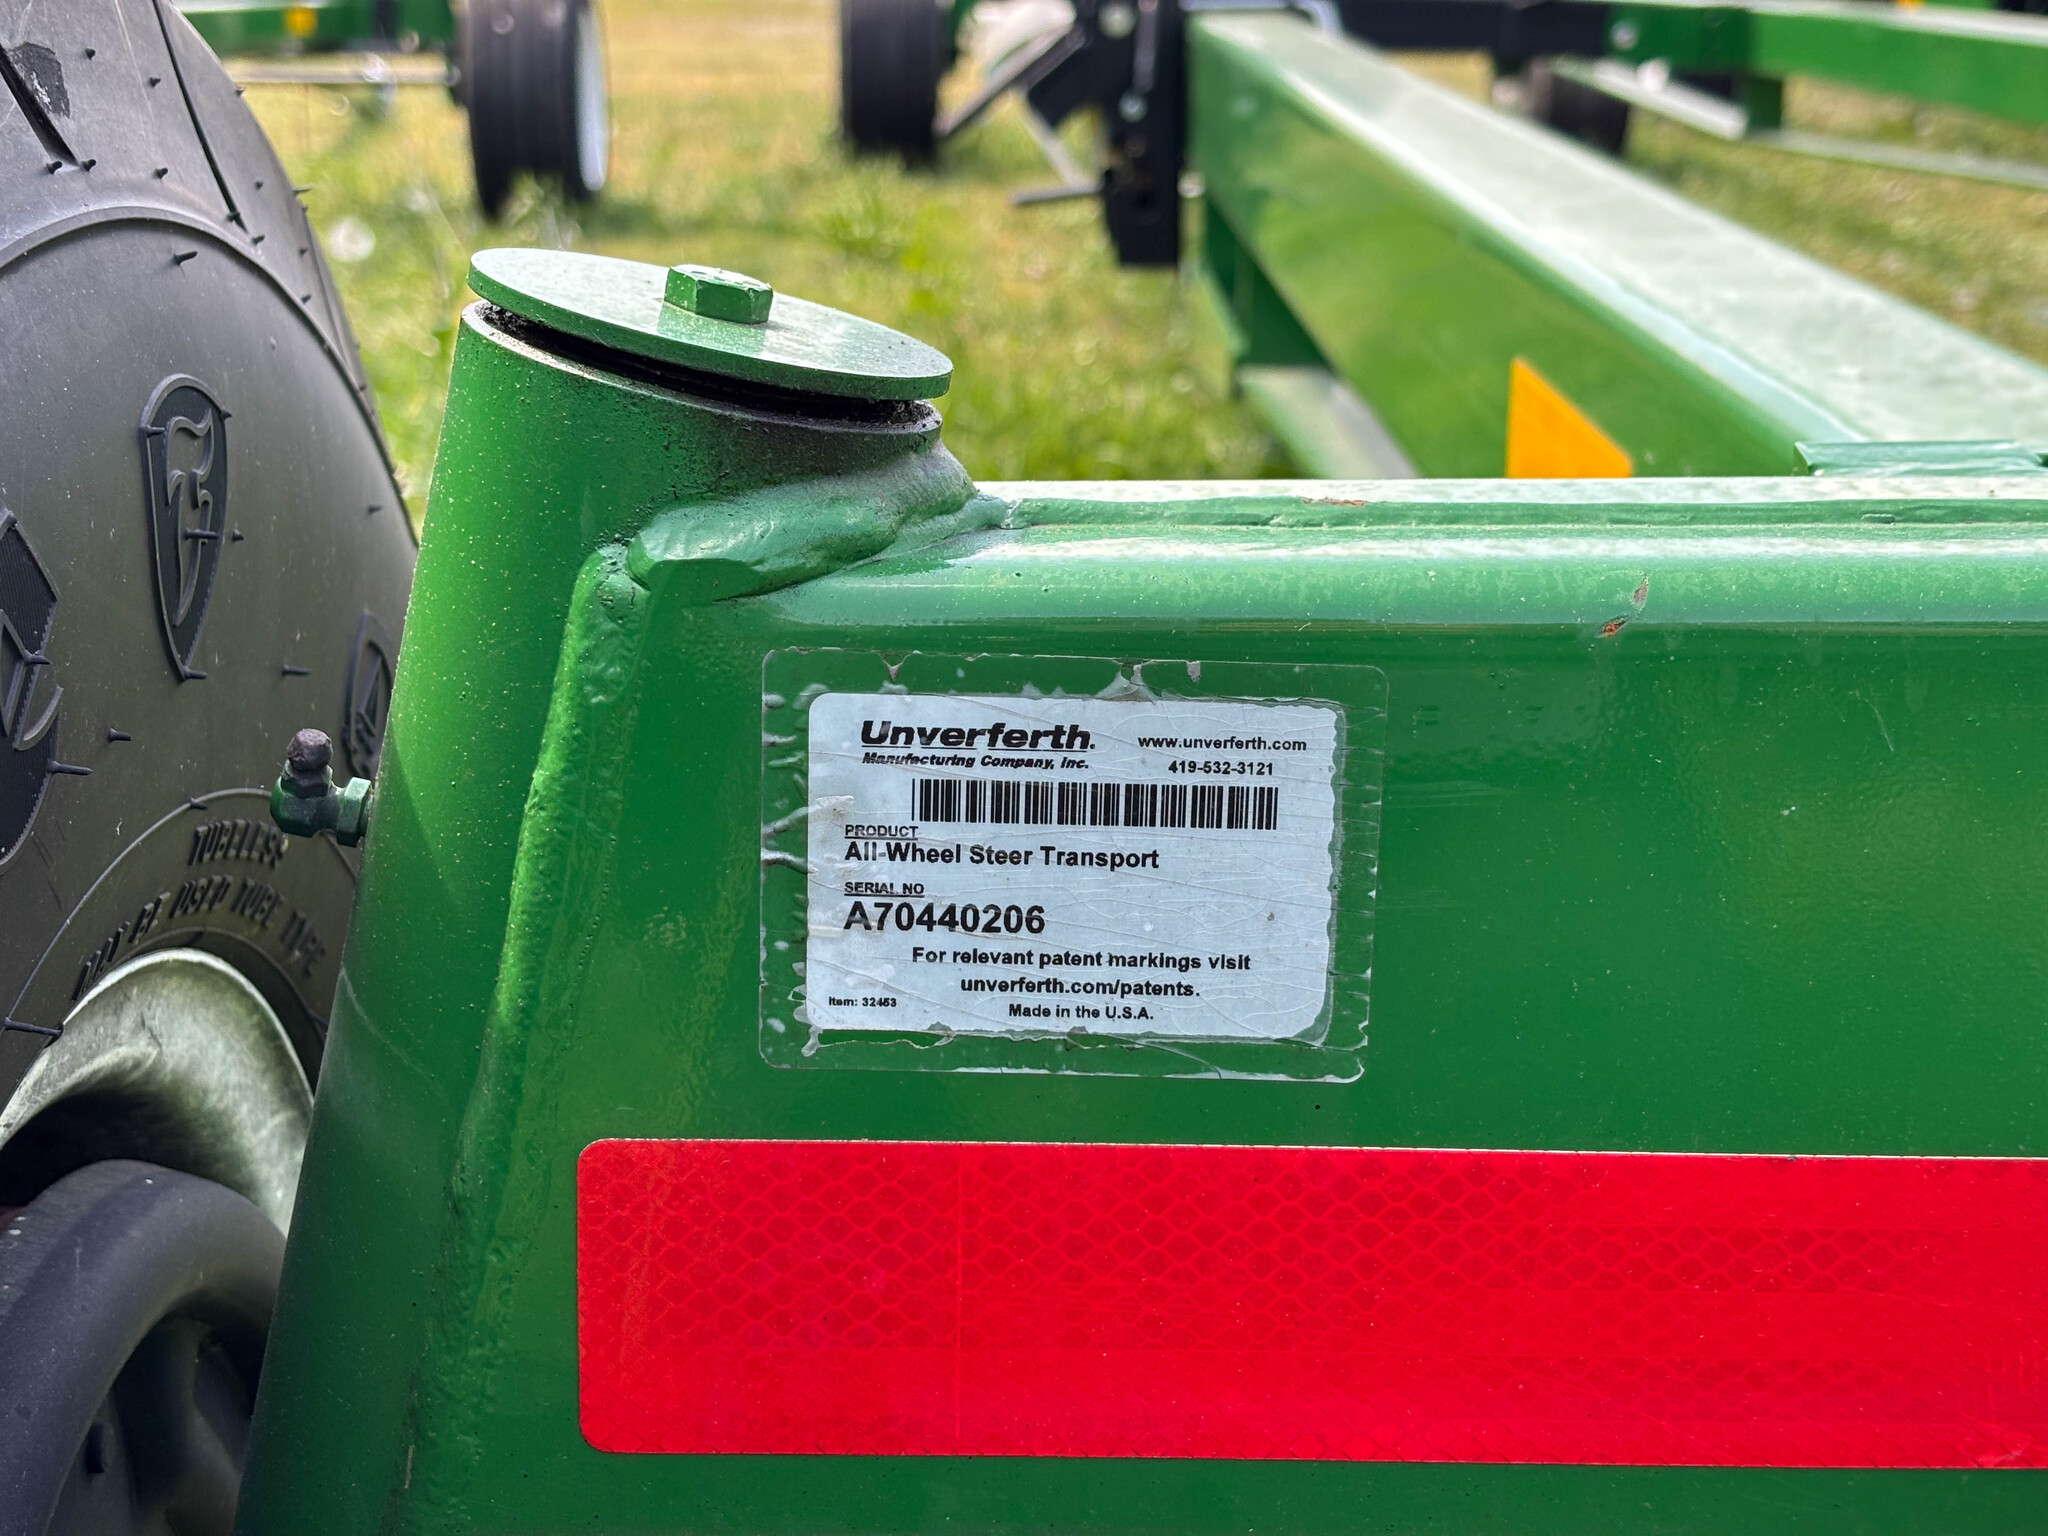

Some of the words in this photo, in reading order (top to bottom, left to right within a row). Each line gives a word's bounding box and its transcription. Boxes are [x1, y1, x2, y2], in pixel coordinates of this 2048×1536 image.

[1138, 736, 1307, 751] www.unverferth.com
[862, 752, 976, 768] Manufacturing
[980, 755, 1055, 770] Company,
[1060, 757, 1089, 769] Inc.
[1168, 760, 1274, 776] 419-532-3121
[844, 824, 919, 840] PRODUCT
[844, 841, 962, 864] All-Wheel
[969, 845, 1033, 866] Steer
[1040, 846, 1160, 871] Transport
[844, 881, 898, 896] SERIAL
[902, 883, 925, 897] NO
[843, 900, 1046, 934] A70440206
[912, 946, 947, 963] For
[952, 948, 1034, 965] relevant
[1039, 951, 1102, 969] patent
[1107, 952, 1202, 972] markings
[1208, 954, 1251, 970] visit
[960, 976, 1200, 998] unverferth.com/patents.
[828, 996, 858, 1007] Item:
[1008, 1003, 1051, 1017] Made
[1055, 1005, 1071, 1018] in
[1075, 1005, 1100, 1019] the
[1105, 1006, 1154, 1020] U.S.A.
